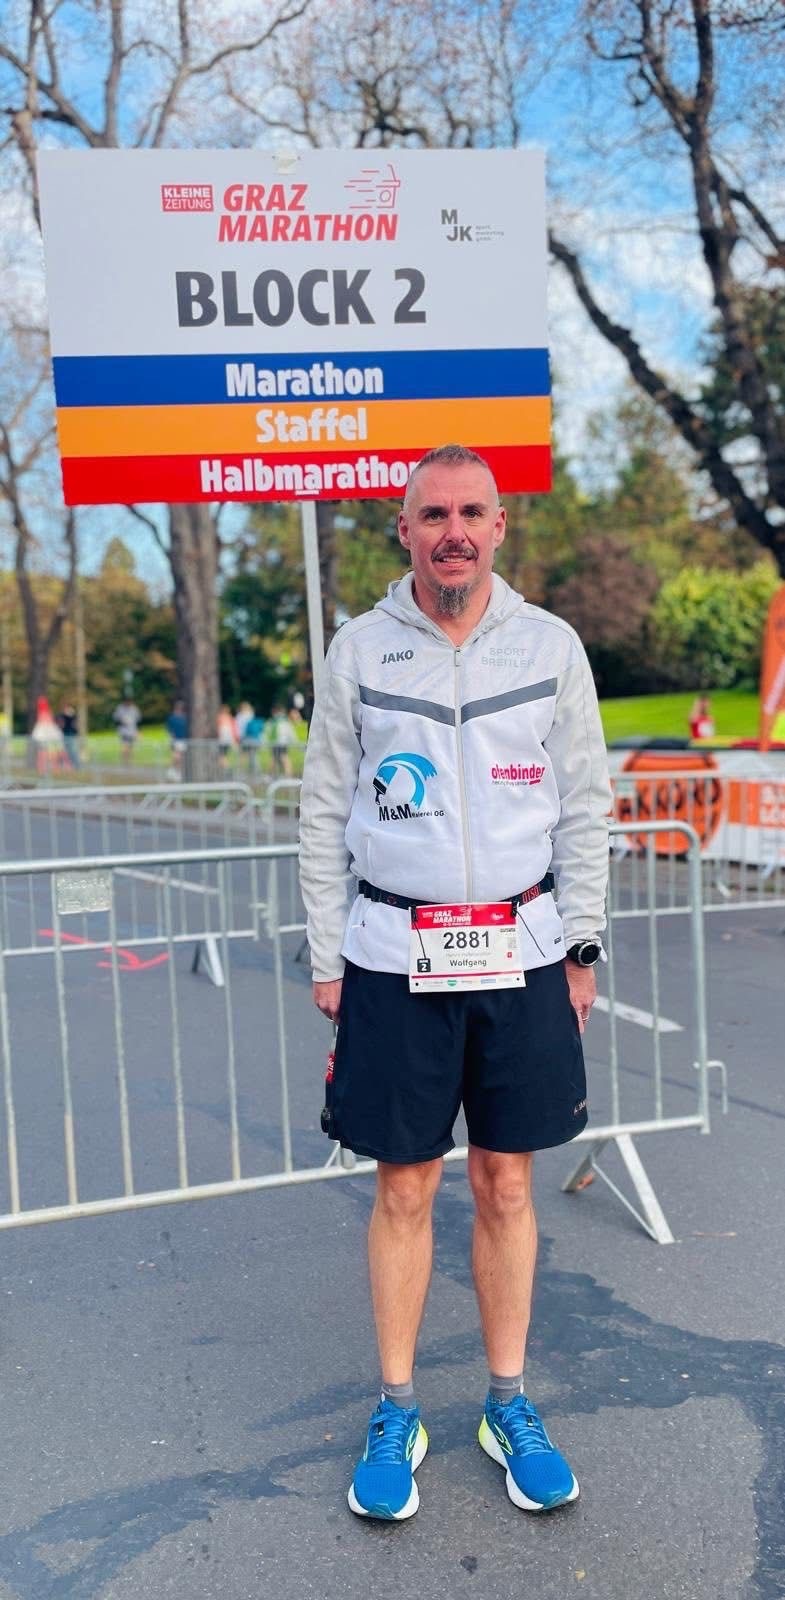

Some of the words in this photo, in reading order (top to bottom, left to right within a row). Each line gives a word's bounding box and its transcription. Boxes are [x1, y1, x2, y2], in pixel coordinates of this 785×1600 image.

[162, 187, 211, 199] KLEINE
[164, 198, 212, 210] ZEITUNG
[222, 184, 309, 212] GRAZ
[217, 213, 399, 242] MARATHON
[175, 269, 375, 327] BLOCK
[394, 268, 427, 324] 2
[225, 363, 384, 397] Marathon
[256, 408, 368, 443] Staffel
[381, 650, 414, 665] JAKO
[489, 647, 528, 656] SPORT
[443, 931, 490, 949] 2881
[449, 959, 487, 968] Wolfgang
